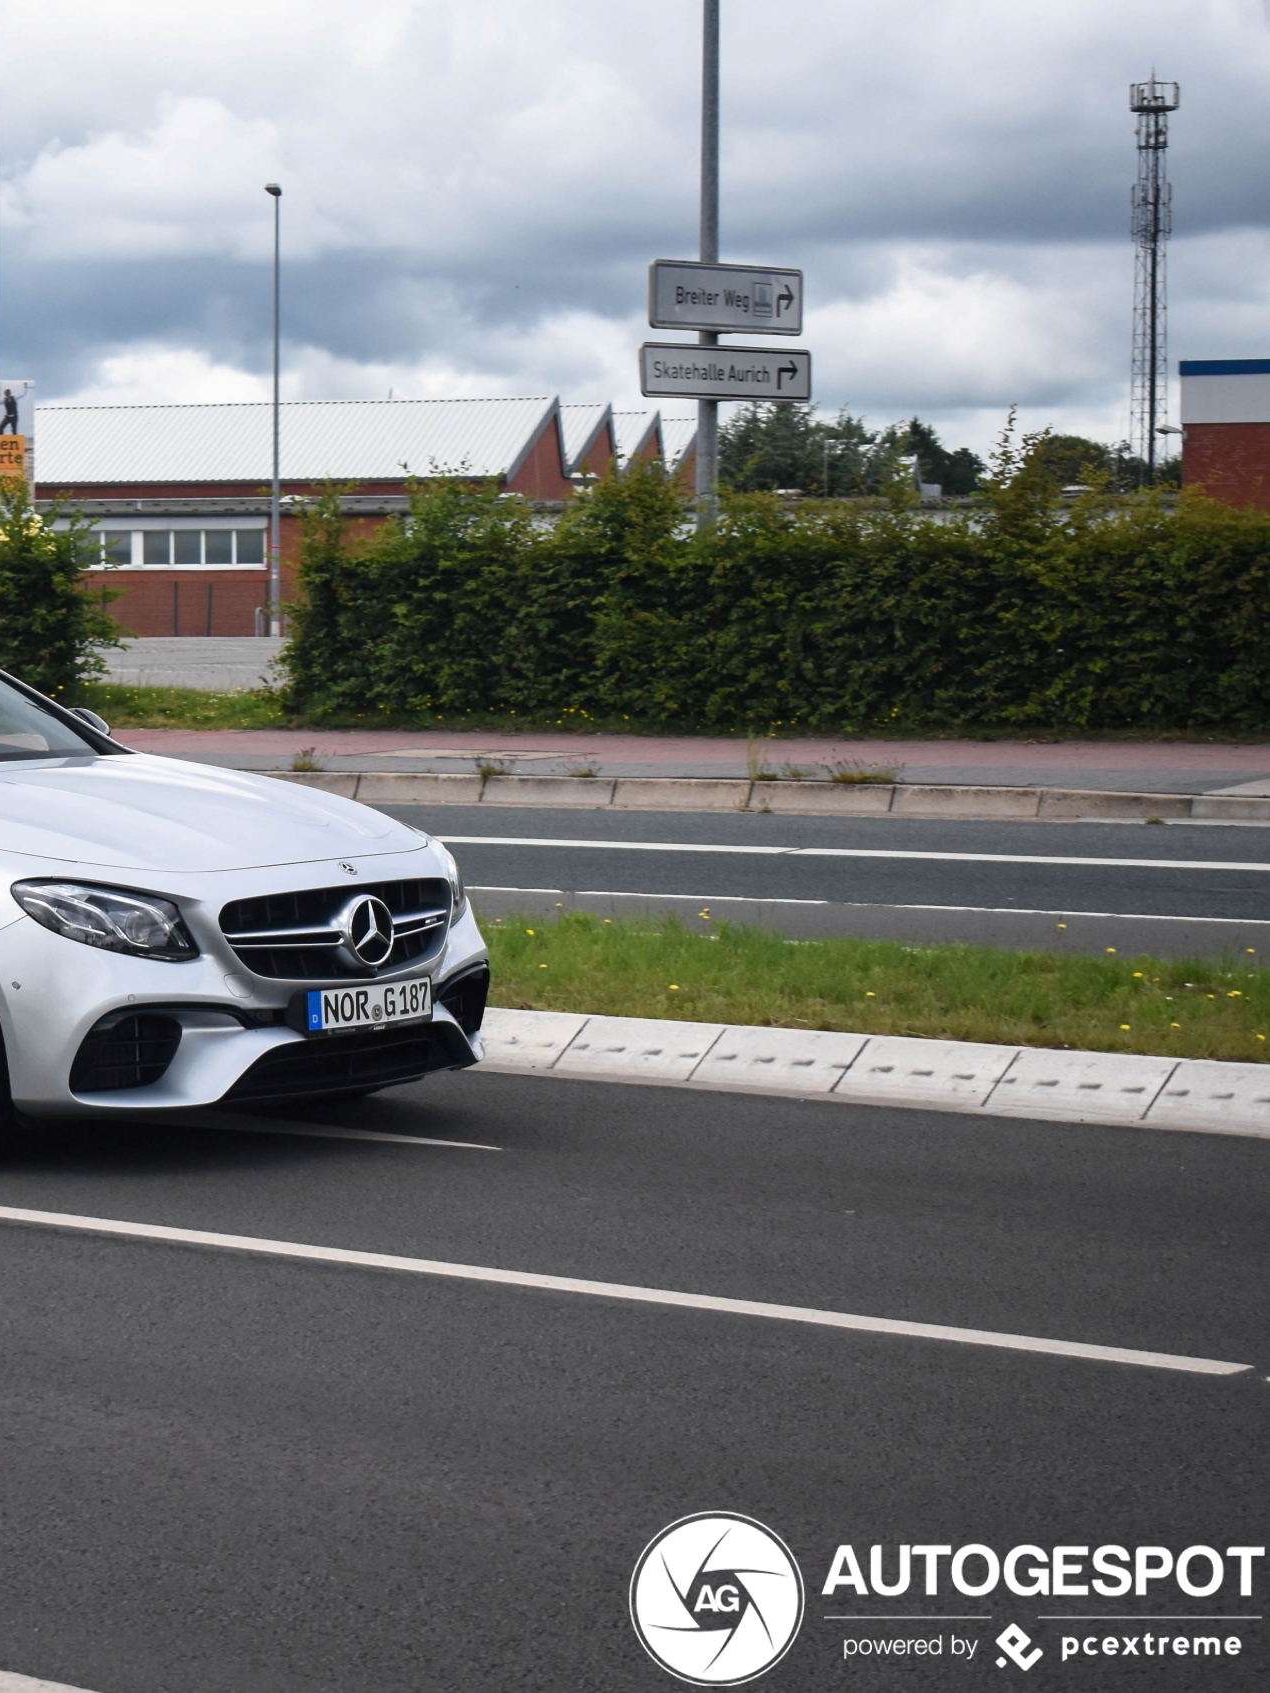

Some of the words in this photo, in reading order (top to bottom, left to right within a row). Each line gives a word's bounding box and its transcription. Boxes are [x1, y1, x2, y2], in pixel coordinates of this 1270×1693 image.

[675, 286, 719, 306] Breiter
[723, 289, 750, 312] Weg
[653, 361, 724, 381] Skatehalle
[727, 365, 770, 383] Aurich
[312, 1014, 318, 1023] D
[324, 990, 369, 1023] NOR
